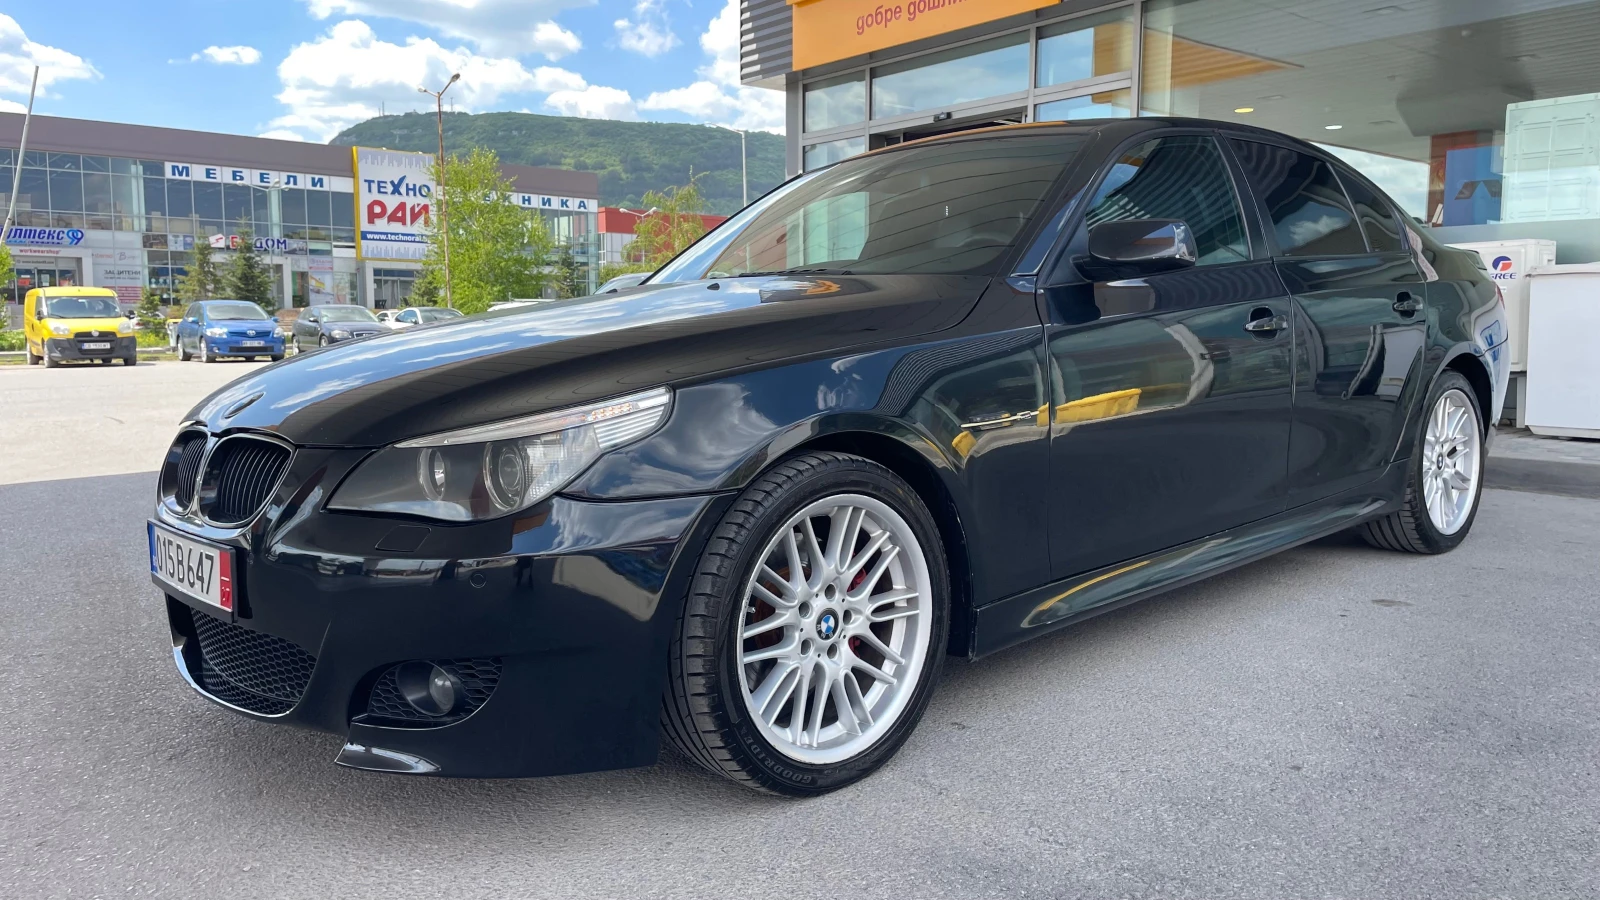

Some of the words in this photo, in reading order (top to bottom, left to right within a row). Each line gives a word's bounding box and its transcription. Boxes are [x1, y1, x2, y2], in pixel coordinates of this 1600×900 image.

[856, 5, 902, 35] добре
[908, 0, 966, 21] дош
[171, 164, 324, 188] МЕБЕЛИ
[363, 174, 431, 198] ТЕХНО
[366, 199, 430, 228] РАЙ
[366, 233, 430, 243] www.technorai.b
[743, 735, 813, 785] GOODRIDE
